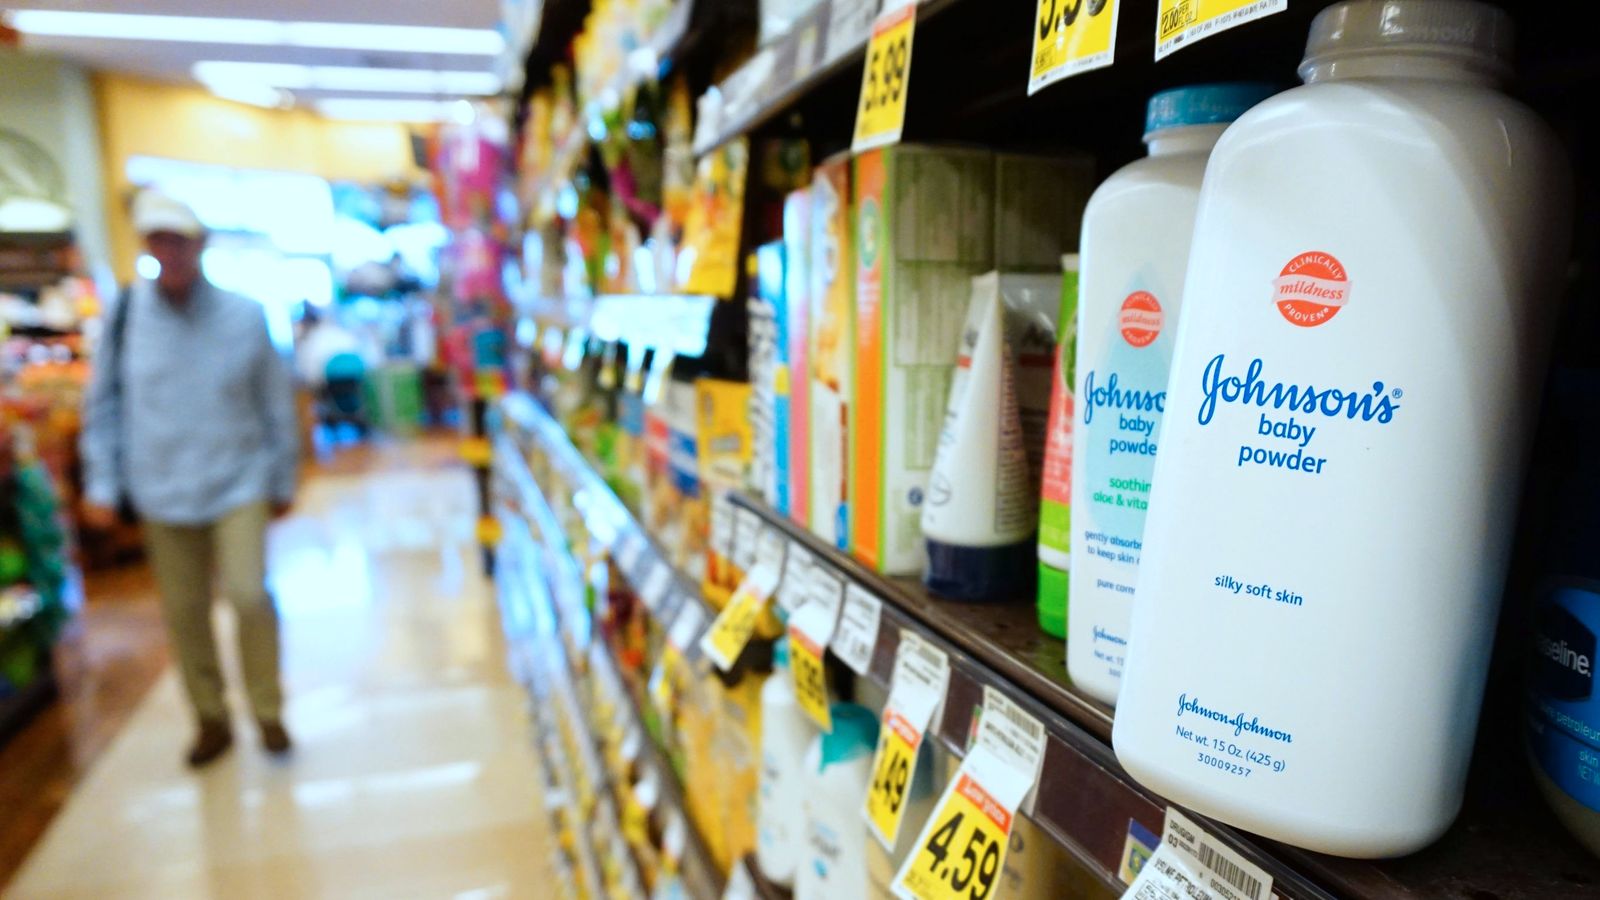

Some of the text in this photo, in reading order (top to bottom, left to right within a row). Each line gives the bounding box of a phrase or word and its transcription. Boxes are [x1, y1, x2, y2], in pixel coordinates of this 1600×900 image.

[1288, 255, 1343, 279] CLINICALLY
[1280, 281, 1343, 299] mildness
[1119, 413, 1155, 437] baby
[1258, 413, 1316, 447] baby
[1238, 445, 1327, 474] powder
[1093, 491, 1114, 505] aloe
[1116, 494, 1125, 507] &
[1085, 531, 1109, 546] gently
[1087, 544, 1096, 554] to
[1097, 547, 1116, 562] keep
[1117, 552, 1135, 566] skin
[1097, 579, 1114, 591] pure
[1215, 575, 1303, 606] silky soft skin
[1176, 725, 1286, 772] Net wt. 15 Oz. (425 g)
[1197, 752, 1252, 777] 30009257
[1168, 833, 1179, 849] 03
[926, 811, 1000, 900] 4.59
